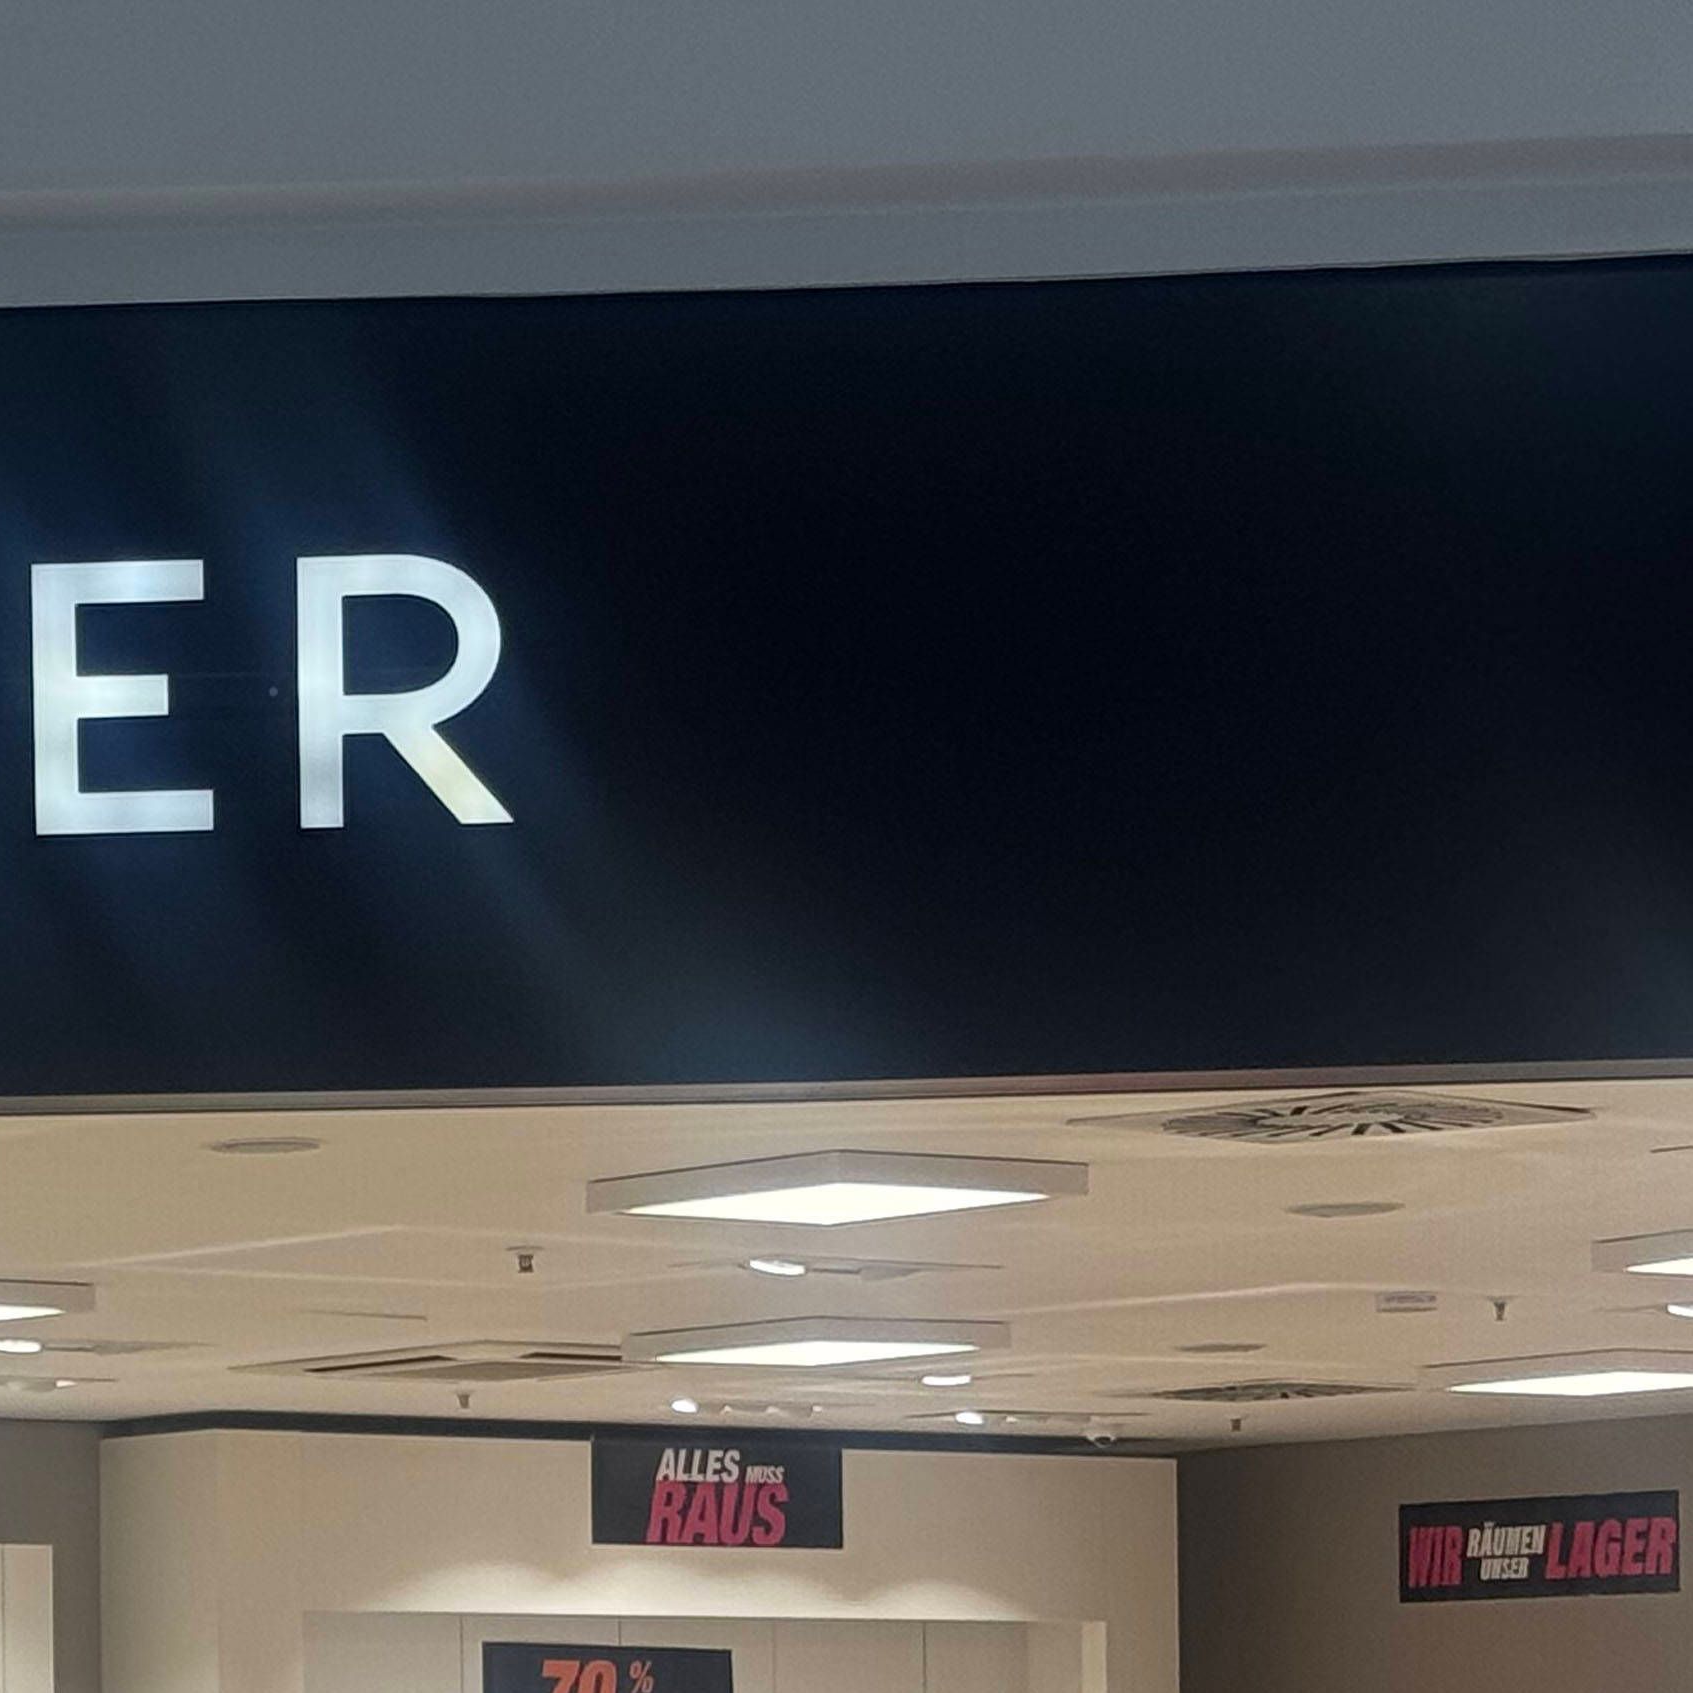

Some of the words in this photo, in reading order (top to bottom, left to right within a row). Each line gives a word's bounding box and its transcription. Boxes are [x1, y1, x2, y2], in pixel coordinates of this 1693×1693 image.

[656, 1448, 740, 1483] ALLES
[745, 1465, 785, 1484] MUSS
[646, 1481, 789, 1545] RAUS
[1408, 1524, 1464, 1588] WIR
[1466, 1521, 1546, 1558] RÄUMEN
[1545, 1516, 1678, 1580] LAGER
[1480, 1557, 1529, 1580] UNSER
